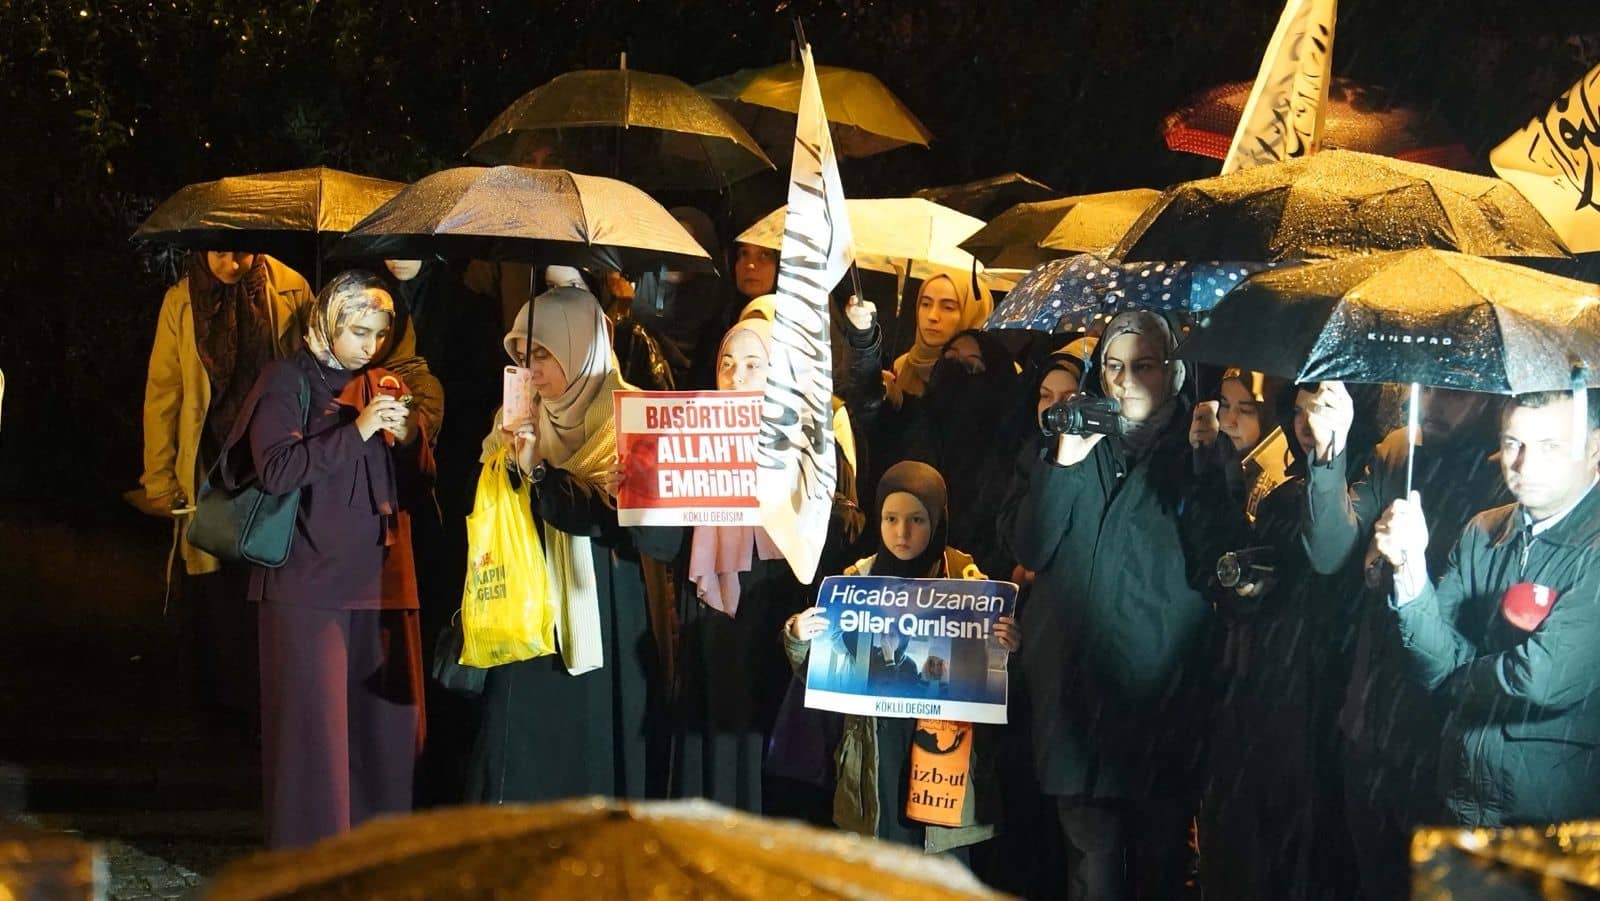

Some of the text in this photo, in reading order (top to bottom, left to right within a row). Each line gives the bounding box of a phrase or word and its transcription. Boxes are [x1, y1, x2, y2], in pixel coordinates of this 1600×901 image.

[646, 400, 763, 431] BAŞÖRTÜSÜ
[658, 435, 760, 464] ALLAH'IN
[830, 585, 1005, 613] Hicaba Uzanan
[840, 610, 990, 640] Əllər Qırılsın!
[914, 764, 965, 786] izb-ut
[912, 789, 958, 809] ahrir
